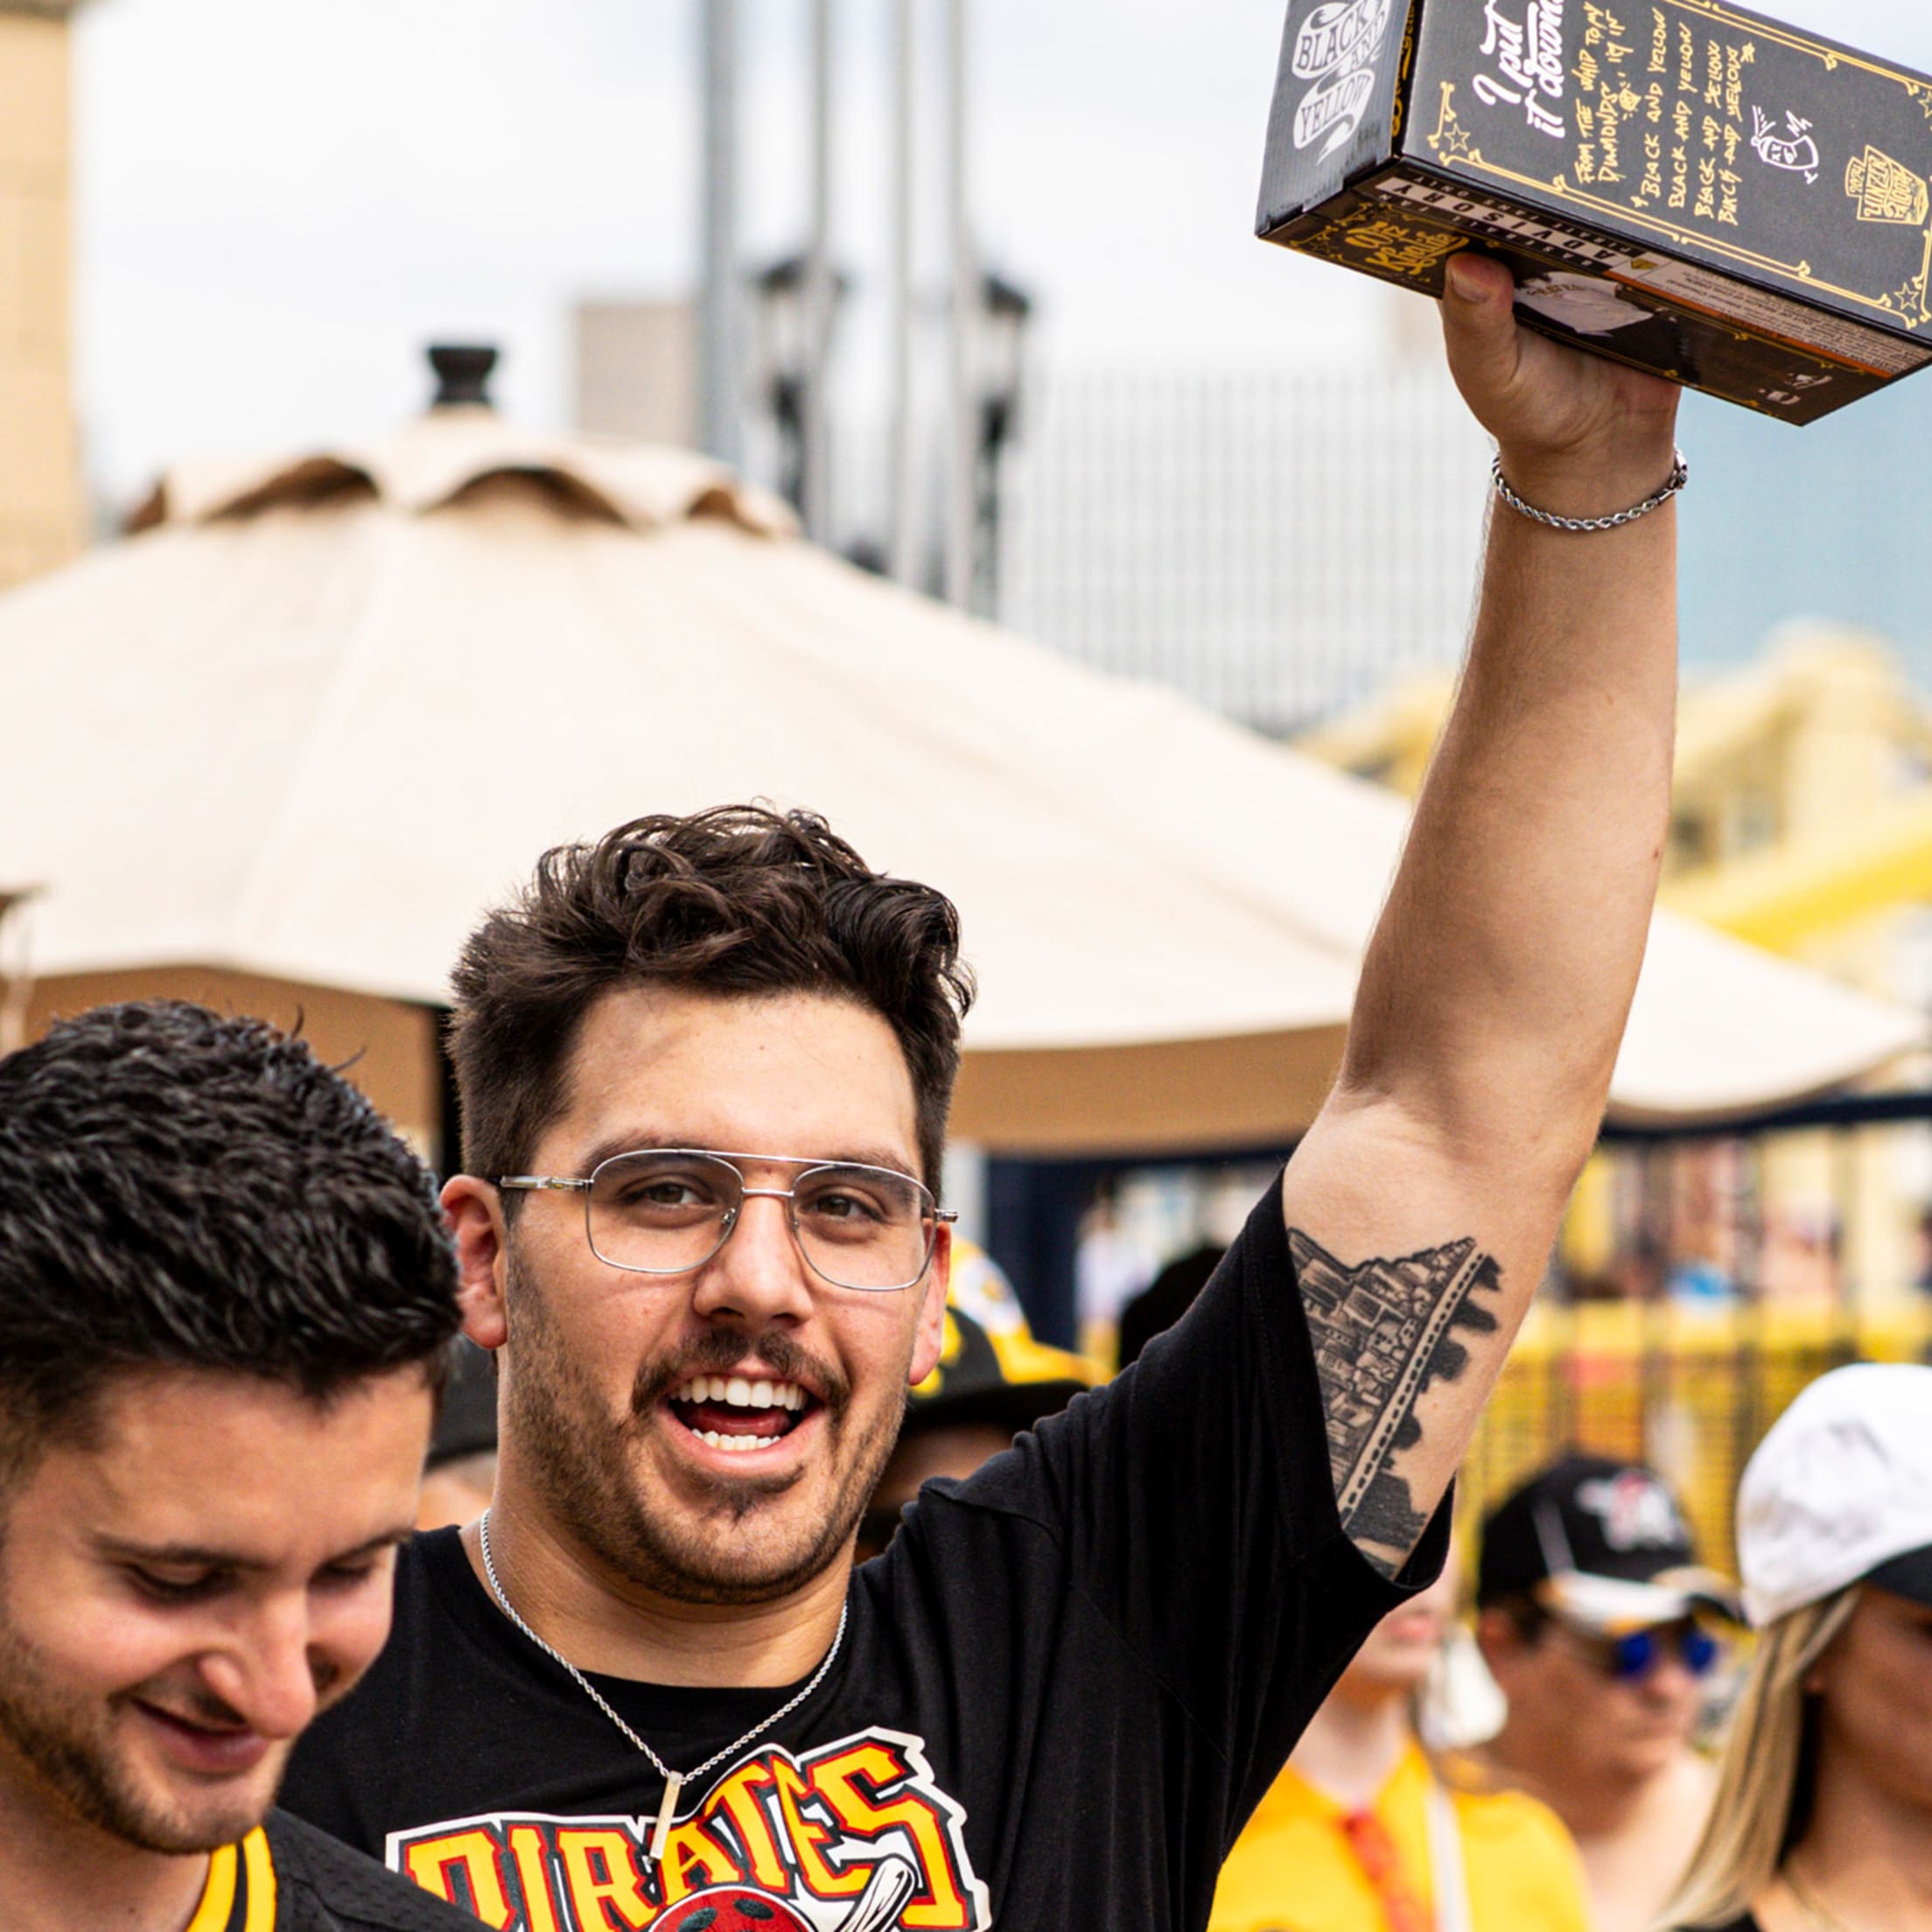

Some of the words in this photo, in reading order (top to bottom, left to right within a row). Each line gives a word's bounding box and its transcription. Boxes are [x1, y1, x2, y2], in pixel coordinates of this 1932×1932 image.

[1295, 0, 1370, 70] BLACK
[1351, 10, 1385, 70] AND
[1479, 0, 1533, 88] put
[1647, 7, 1667, 73] YELLOW
[1677, 22, 1698, 93] YELLOW
[1473, 74, 1521, 105] I
[1644, 82, 1662, 122] AND
[1704, 40, 1723, 108] YELLOW
[1300, 74, 1372, 143] YELLOW
[1524, 88, 1565, 138] it
[1576, 98, 1594, 138] THE
[1672, 101, 1692, 141] AND
[1701, 116, 1721, 150] AND
[1575, 144, 1595, 184] FROM
[1641, 133, 1662, 198] BLACK
[1723, 123, 1742, 164] AND
[1668, 146, 1687, 208] BLACK
[1694, 158, 1716, 219] BLACK
[1392, 183, 1617, 260] ADVISORY
[397, 1734, 980, 1932] PIRATES
